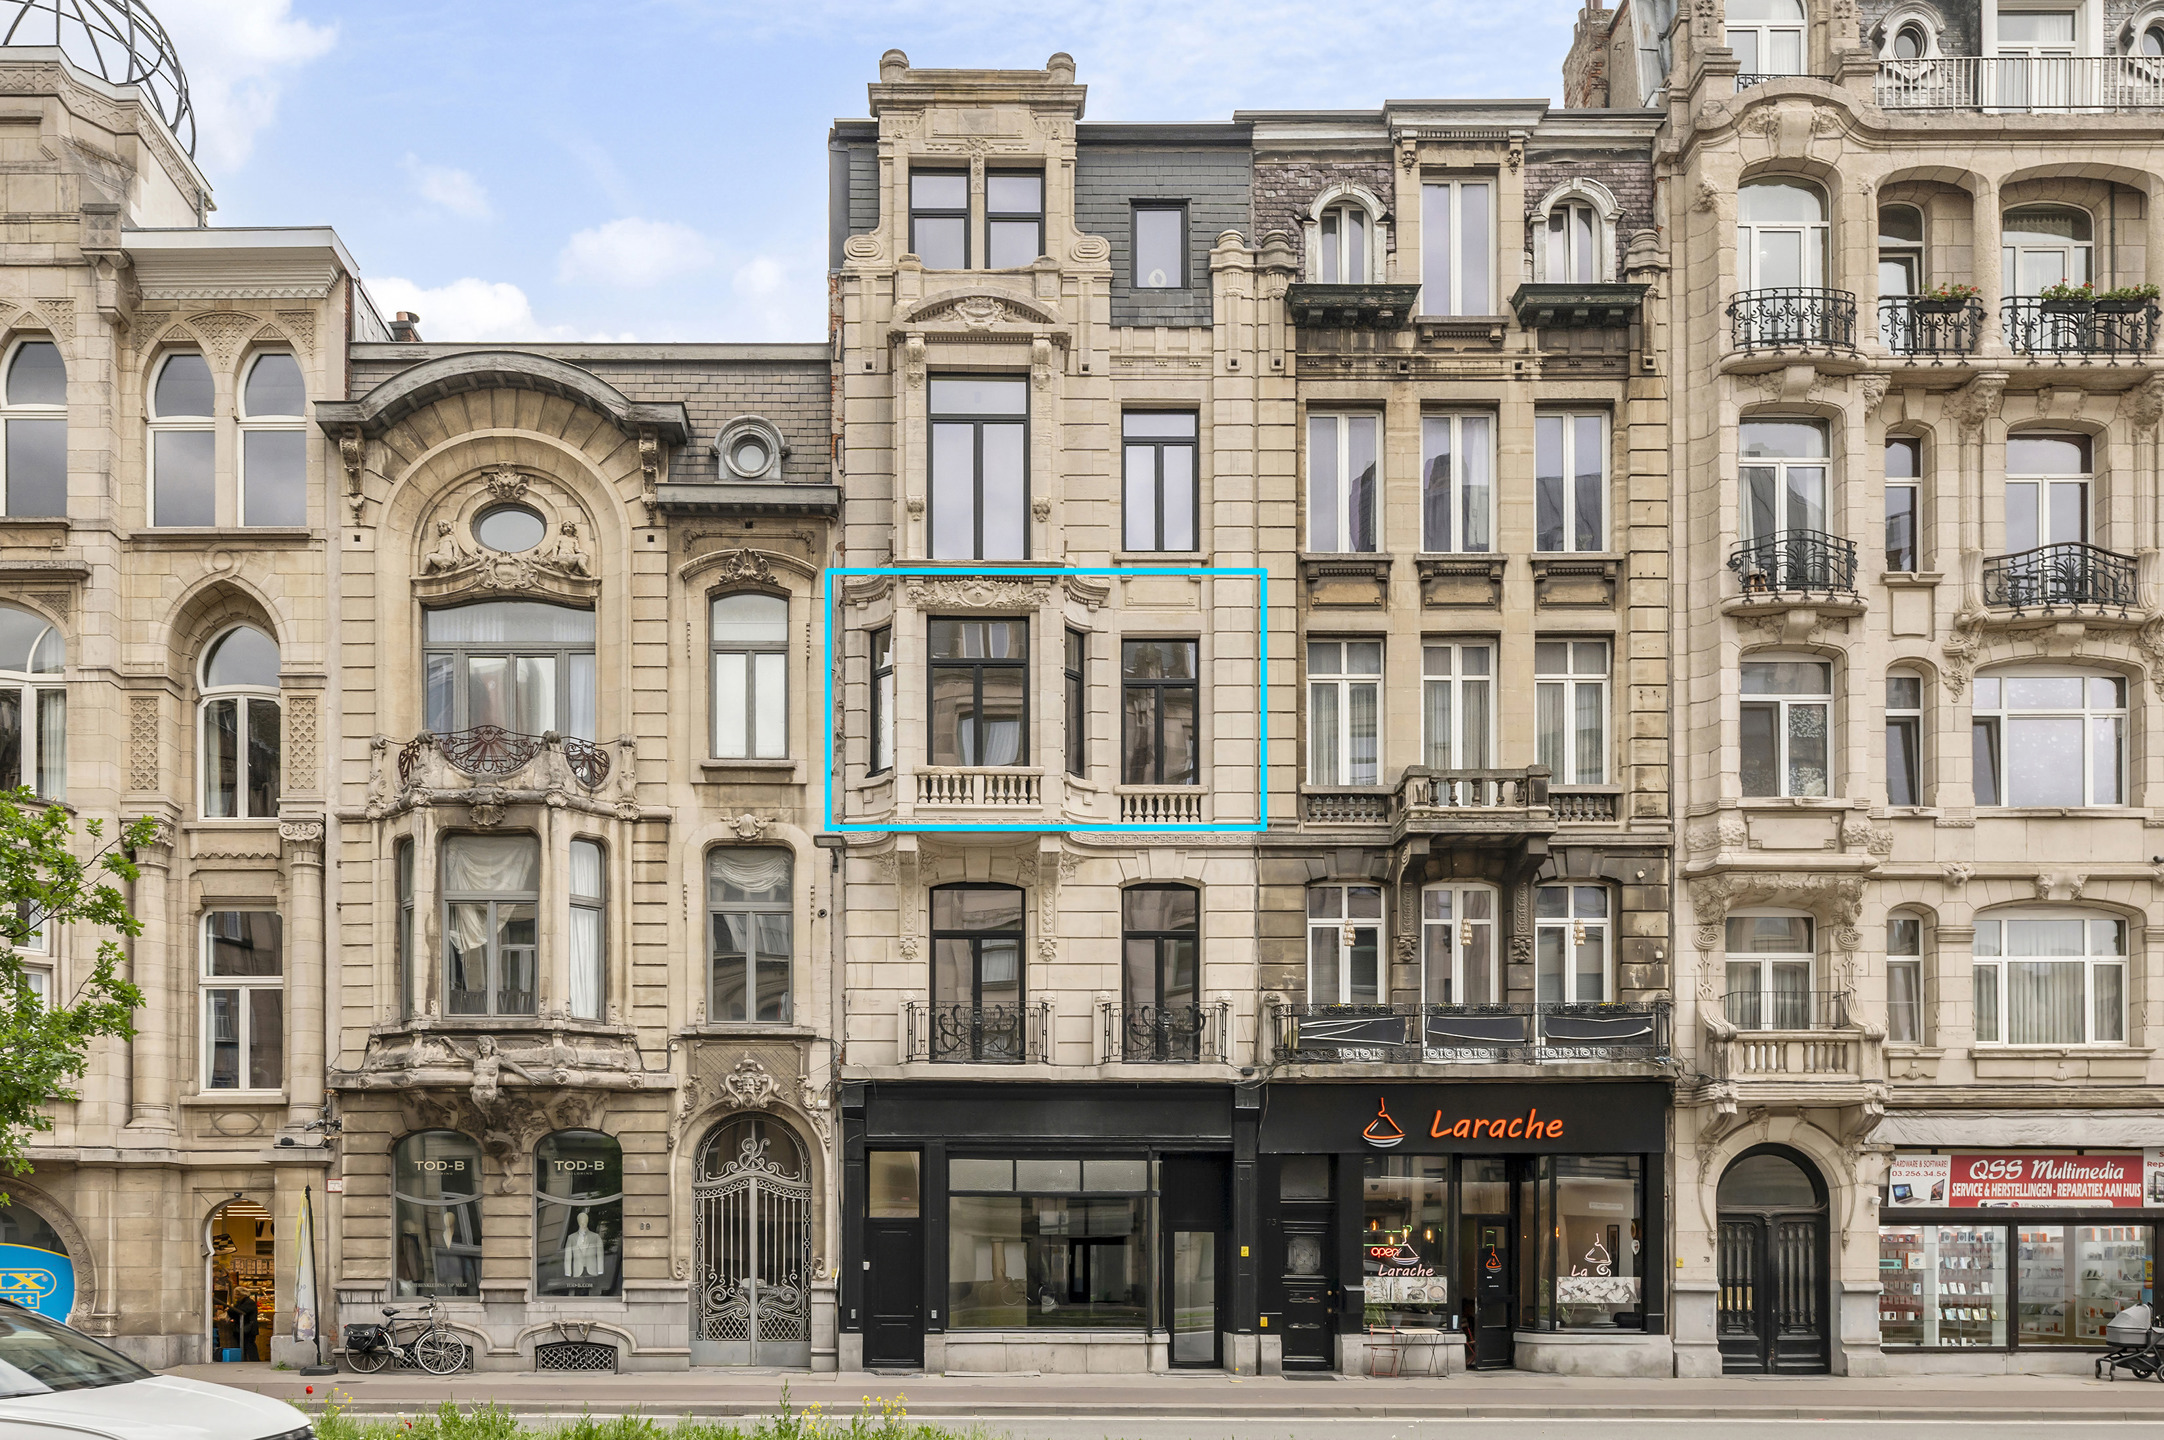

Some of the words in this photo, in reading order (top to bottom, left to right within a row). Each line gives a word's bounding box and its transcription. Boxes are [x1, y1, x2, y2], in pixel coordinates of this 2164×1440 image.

[1430, 1108, 1564, 1140] Larache
[414, 1160, 465, 1171] TOD-B
[554, 1160, 605, 1171] TOD-B
[1892, 1160, 1919, 1168] HARDWARE
[1969, 1159, 2023, 1180] QSS
[2031, 1159, 2125, 1180] Multimedia
[1952, 1182, 1983, 1197] SERVICE
[1984, 1182, 1990, 1197] &
[1991, 1182, 2053, 1197] HERSTELLINGEN
[2057, 1182, 2103, 1197] REPARATIES
[2104, 1182, 2122, 1197] AAN
[2123, 1182, 2142, 1197] HUIS
[1371, 1247, 1399, 1258] open
[1378, 1263, 1435, 1277] Larache
[1571, 1265, 1588, 1277] La
